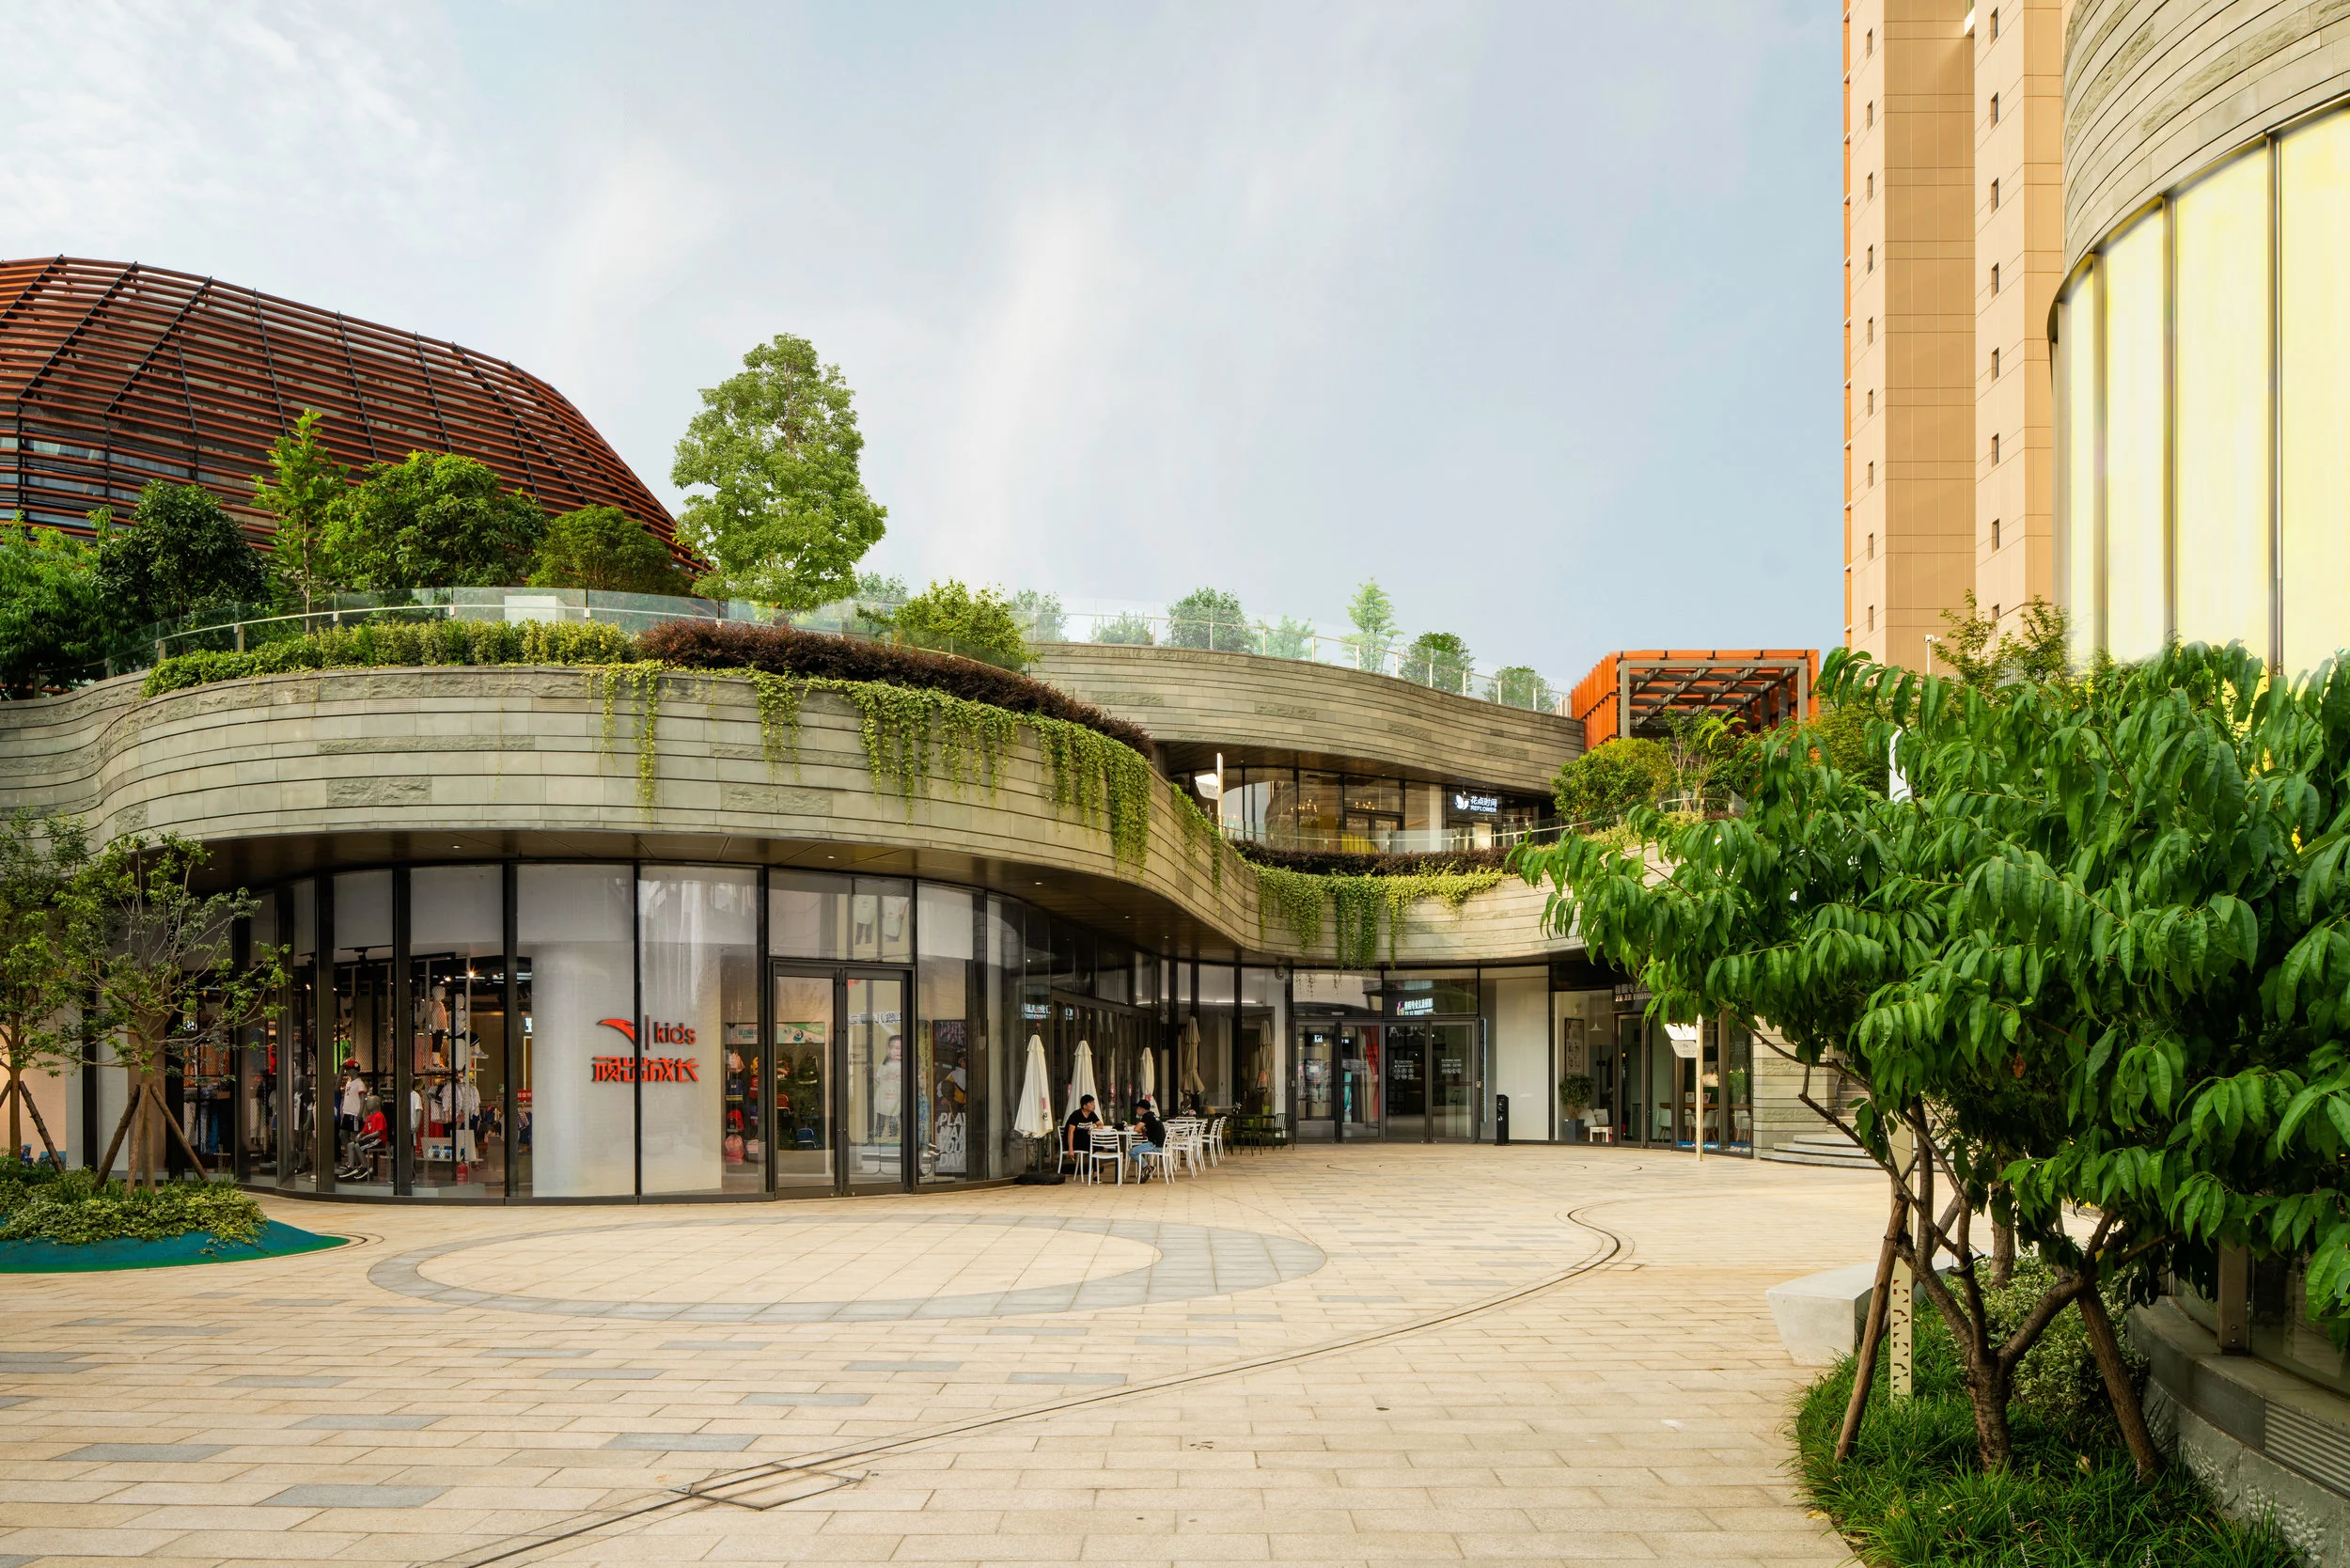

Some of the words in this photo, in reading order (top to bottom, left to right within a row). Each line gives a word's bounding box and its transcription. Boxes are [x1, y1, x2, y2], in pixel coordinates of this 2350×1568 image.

[1470, 795, 1497, 808] 花点时间
[653, 1022, 697, 1044] kids
